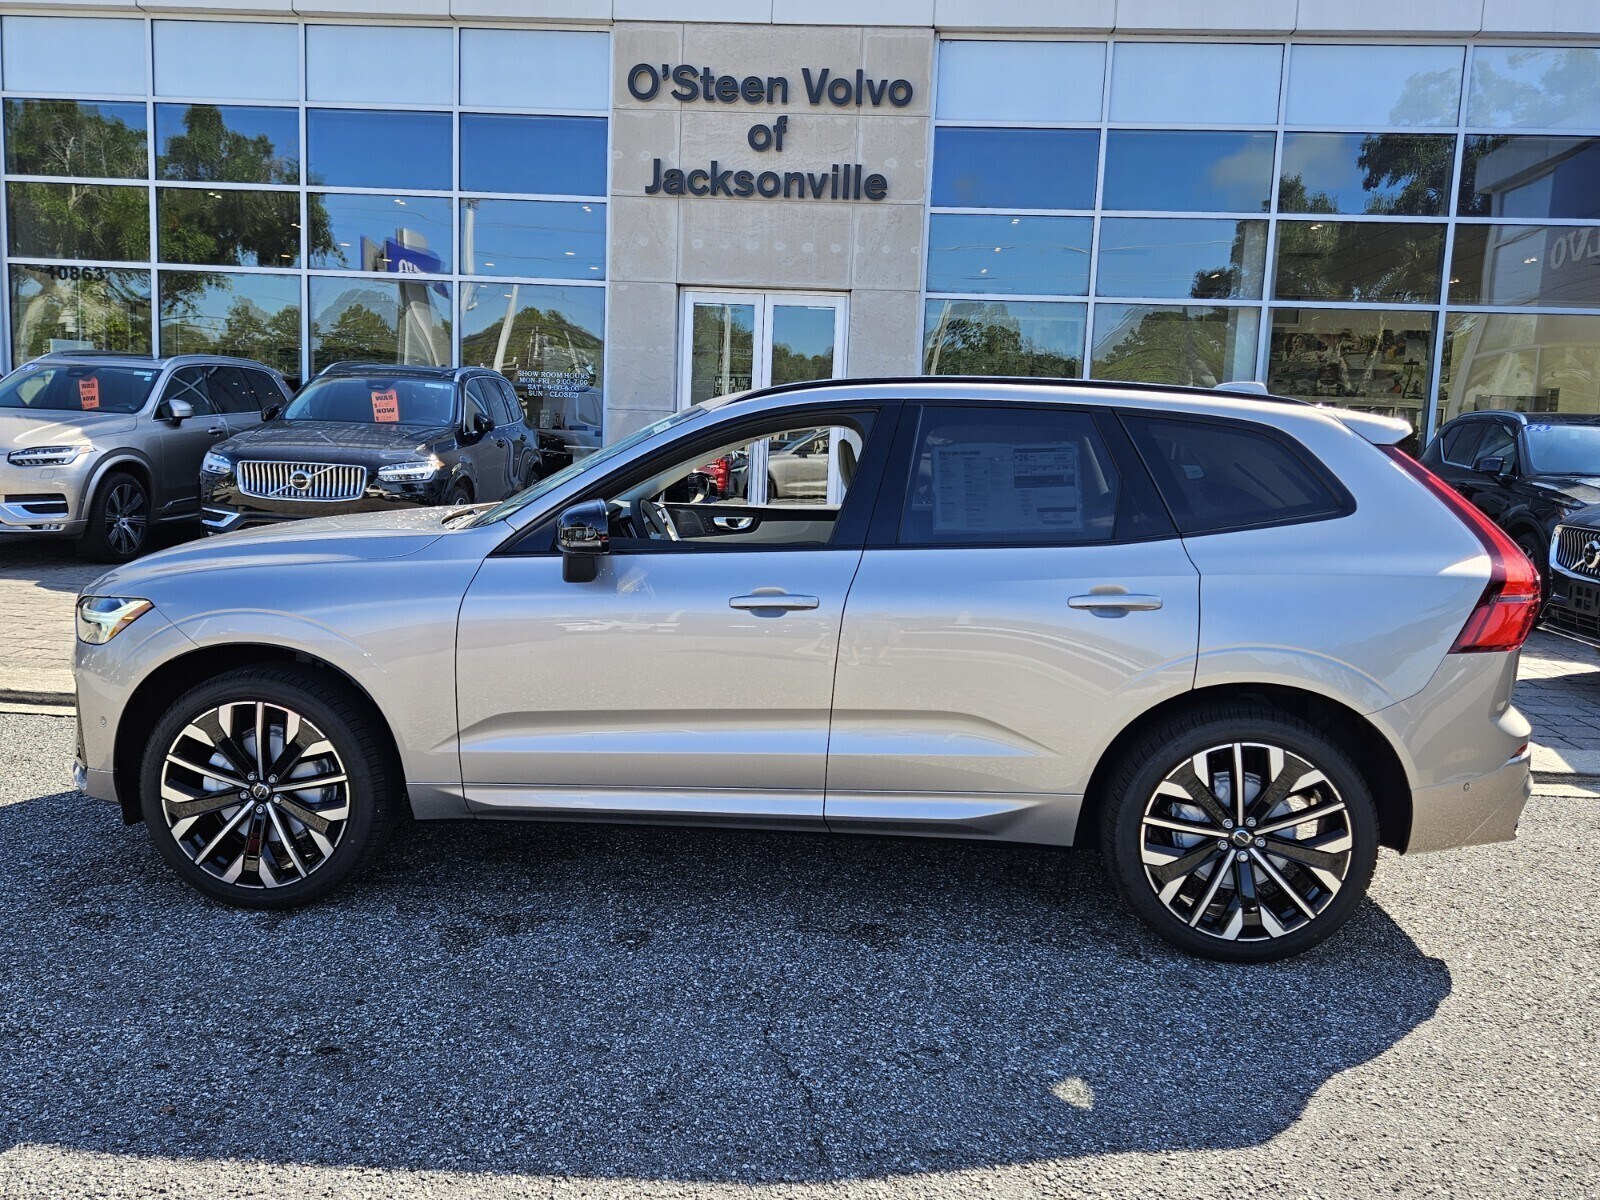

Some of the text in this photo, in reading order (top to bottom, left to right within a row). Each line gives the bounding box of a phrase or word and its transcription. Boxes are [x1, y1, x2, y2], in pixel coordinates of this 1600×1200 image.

[627, 63, 913, 108] O'Steen Volvo
[747, 115, 788, 152] of
[645, 158, 888, 201] Jacksonville
[49, 265, 105, 281] 10863
[549, 391, 579, 399] CLOSED
